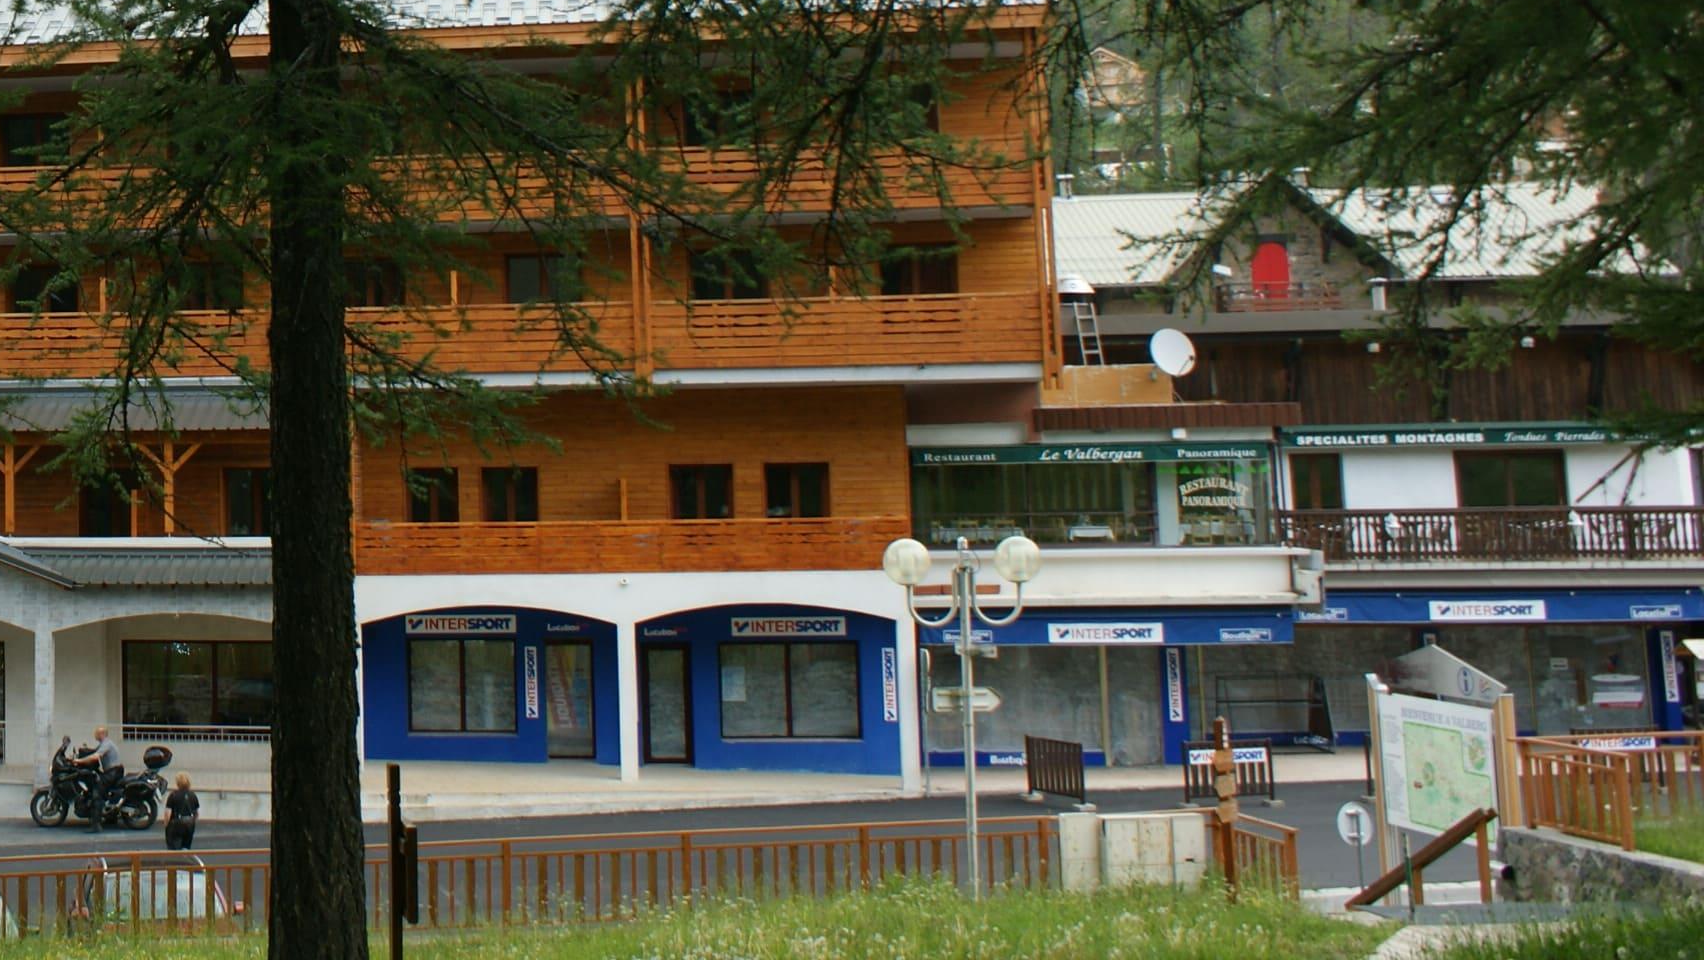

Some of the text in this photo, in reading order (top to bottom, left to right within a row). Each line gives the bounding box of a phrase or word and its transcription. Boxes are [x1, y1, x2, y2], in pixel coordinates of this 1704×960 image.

[1296, 434, 1387, 445] SPECIALITES
[1395, 432, 1484, 444] MONTAGNES
[923, 447, 1257, 463] Restaurant Le Valbergan Panoramique
[1179, 477, 1249, 496] RESTAURANT
[1182, 495, 1246, 510] PANORAMIQUE
[1453, 605, 1533, 616] INTERSPORT
[424, 617, 511, 630] INTERSPORT
[751, 620, 840, 633] INTERSPORT
[1071, 627, 1153, 639] INTERSPORT
[527, 648, 536, 706] INTERSPORT
[884, 649, 894, 709] INTERSPORT
[1202, 750, 1263, 761] INSPORT
